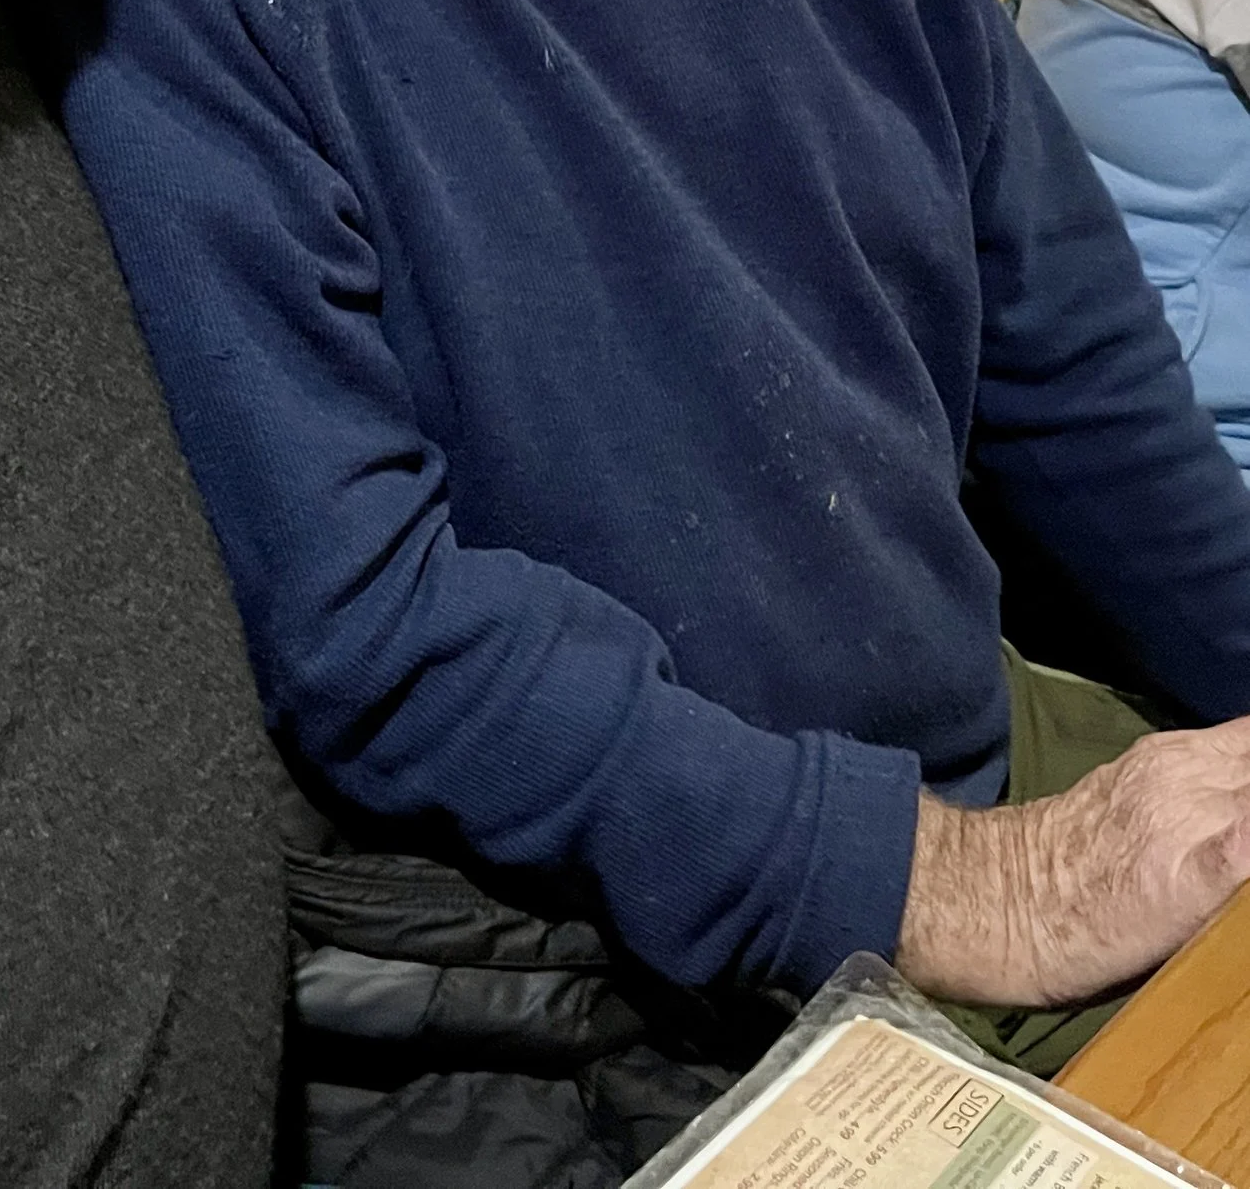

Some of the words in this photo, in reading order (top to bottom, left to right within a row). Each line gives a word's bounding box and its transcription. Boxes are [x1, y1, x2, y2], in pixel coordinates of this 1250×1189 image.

[940, 1088, 990, 1136] SIDES
[792, 1135, 822, 1164] Onion
[1042, 1148, 1060, 1168] with
[1059, 1151, 1089, 1184] French
